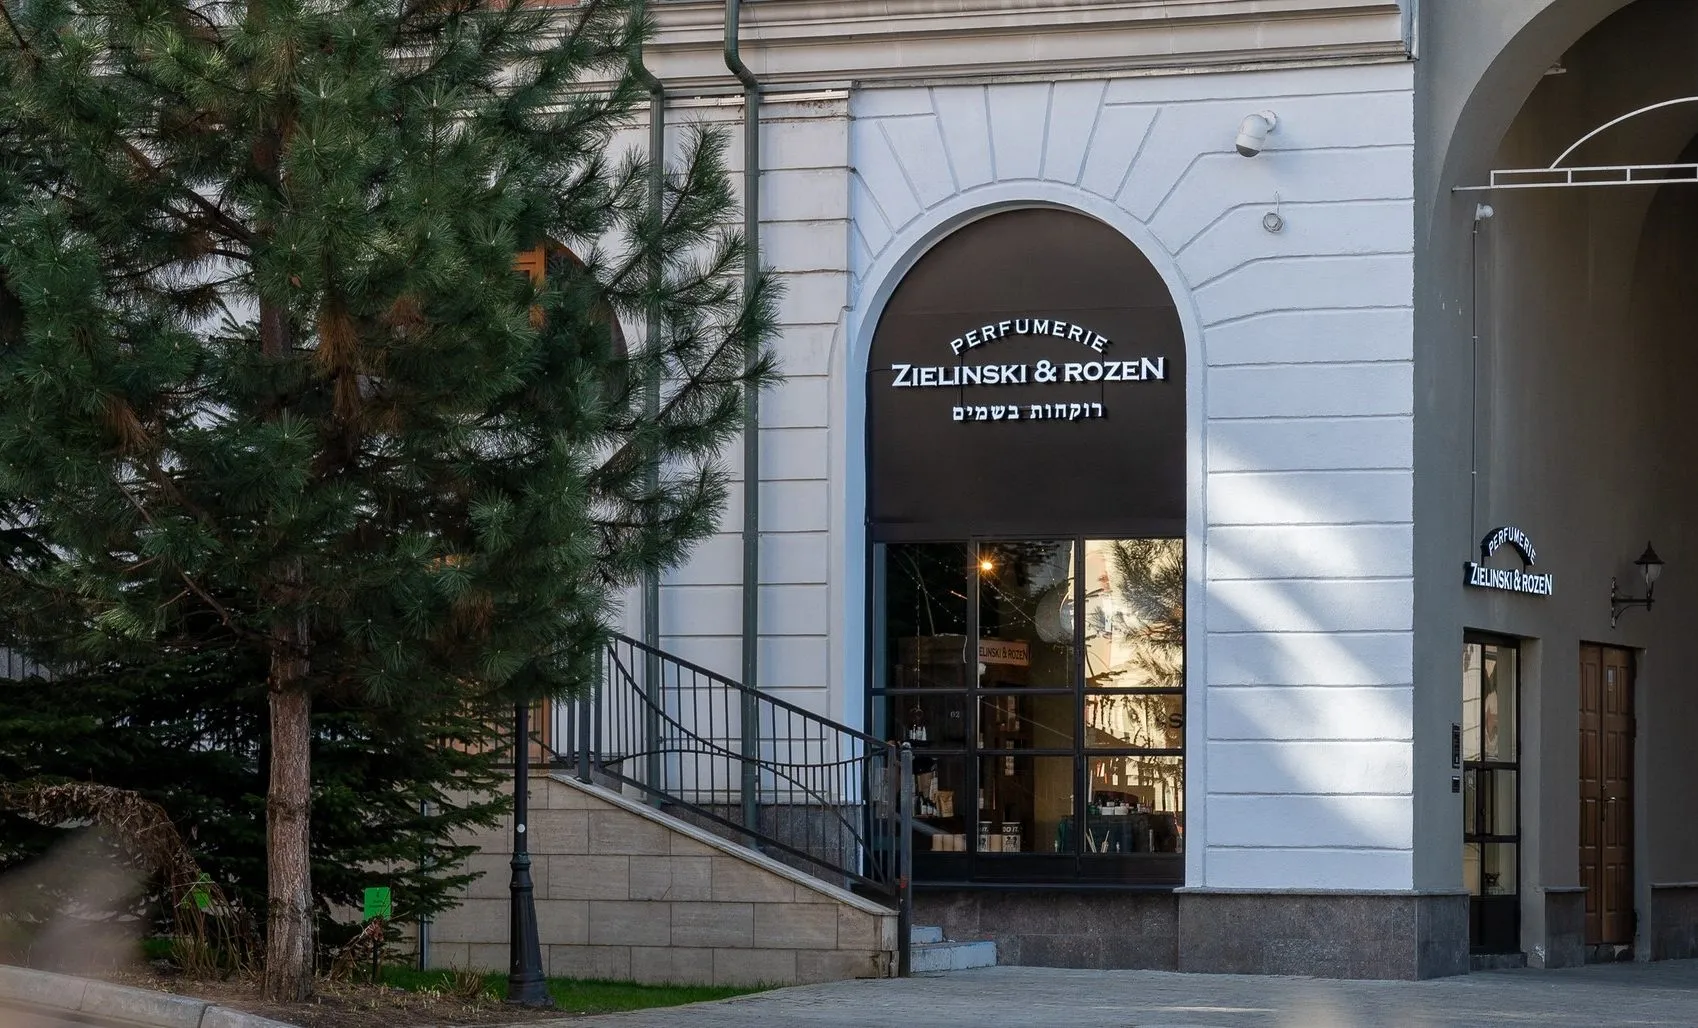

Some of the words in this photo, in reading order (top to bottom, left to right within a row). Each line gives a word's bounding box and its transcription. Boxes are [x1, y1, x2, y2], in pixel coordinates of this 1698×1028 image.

[950, 318, 1108, 356] PERFUMERIE
[891, 363, 1027, 387] ZIELINSKI
[1034, 359, 1056, 382] &
[1064, 356, 1165, 383] ROZEN
[952, 404, 1020, 421] בשמים
[1029, 402, 1102, 420] רוקחות
[1488, 526, 1537, 566] PERFUMERIE
[1470, 562, 1513, 590] ZIELINSKI
[1513, 569, 1521, 592] &
[1522, 573, 1553, 596] ROZEN
[979, 646, 1001, 659] ELINSKI
[1002, 646, 1008, 659] &
[1008, 648, 1028, 661] ROZEN
